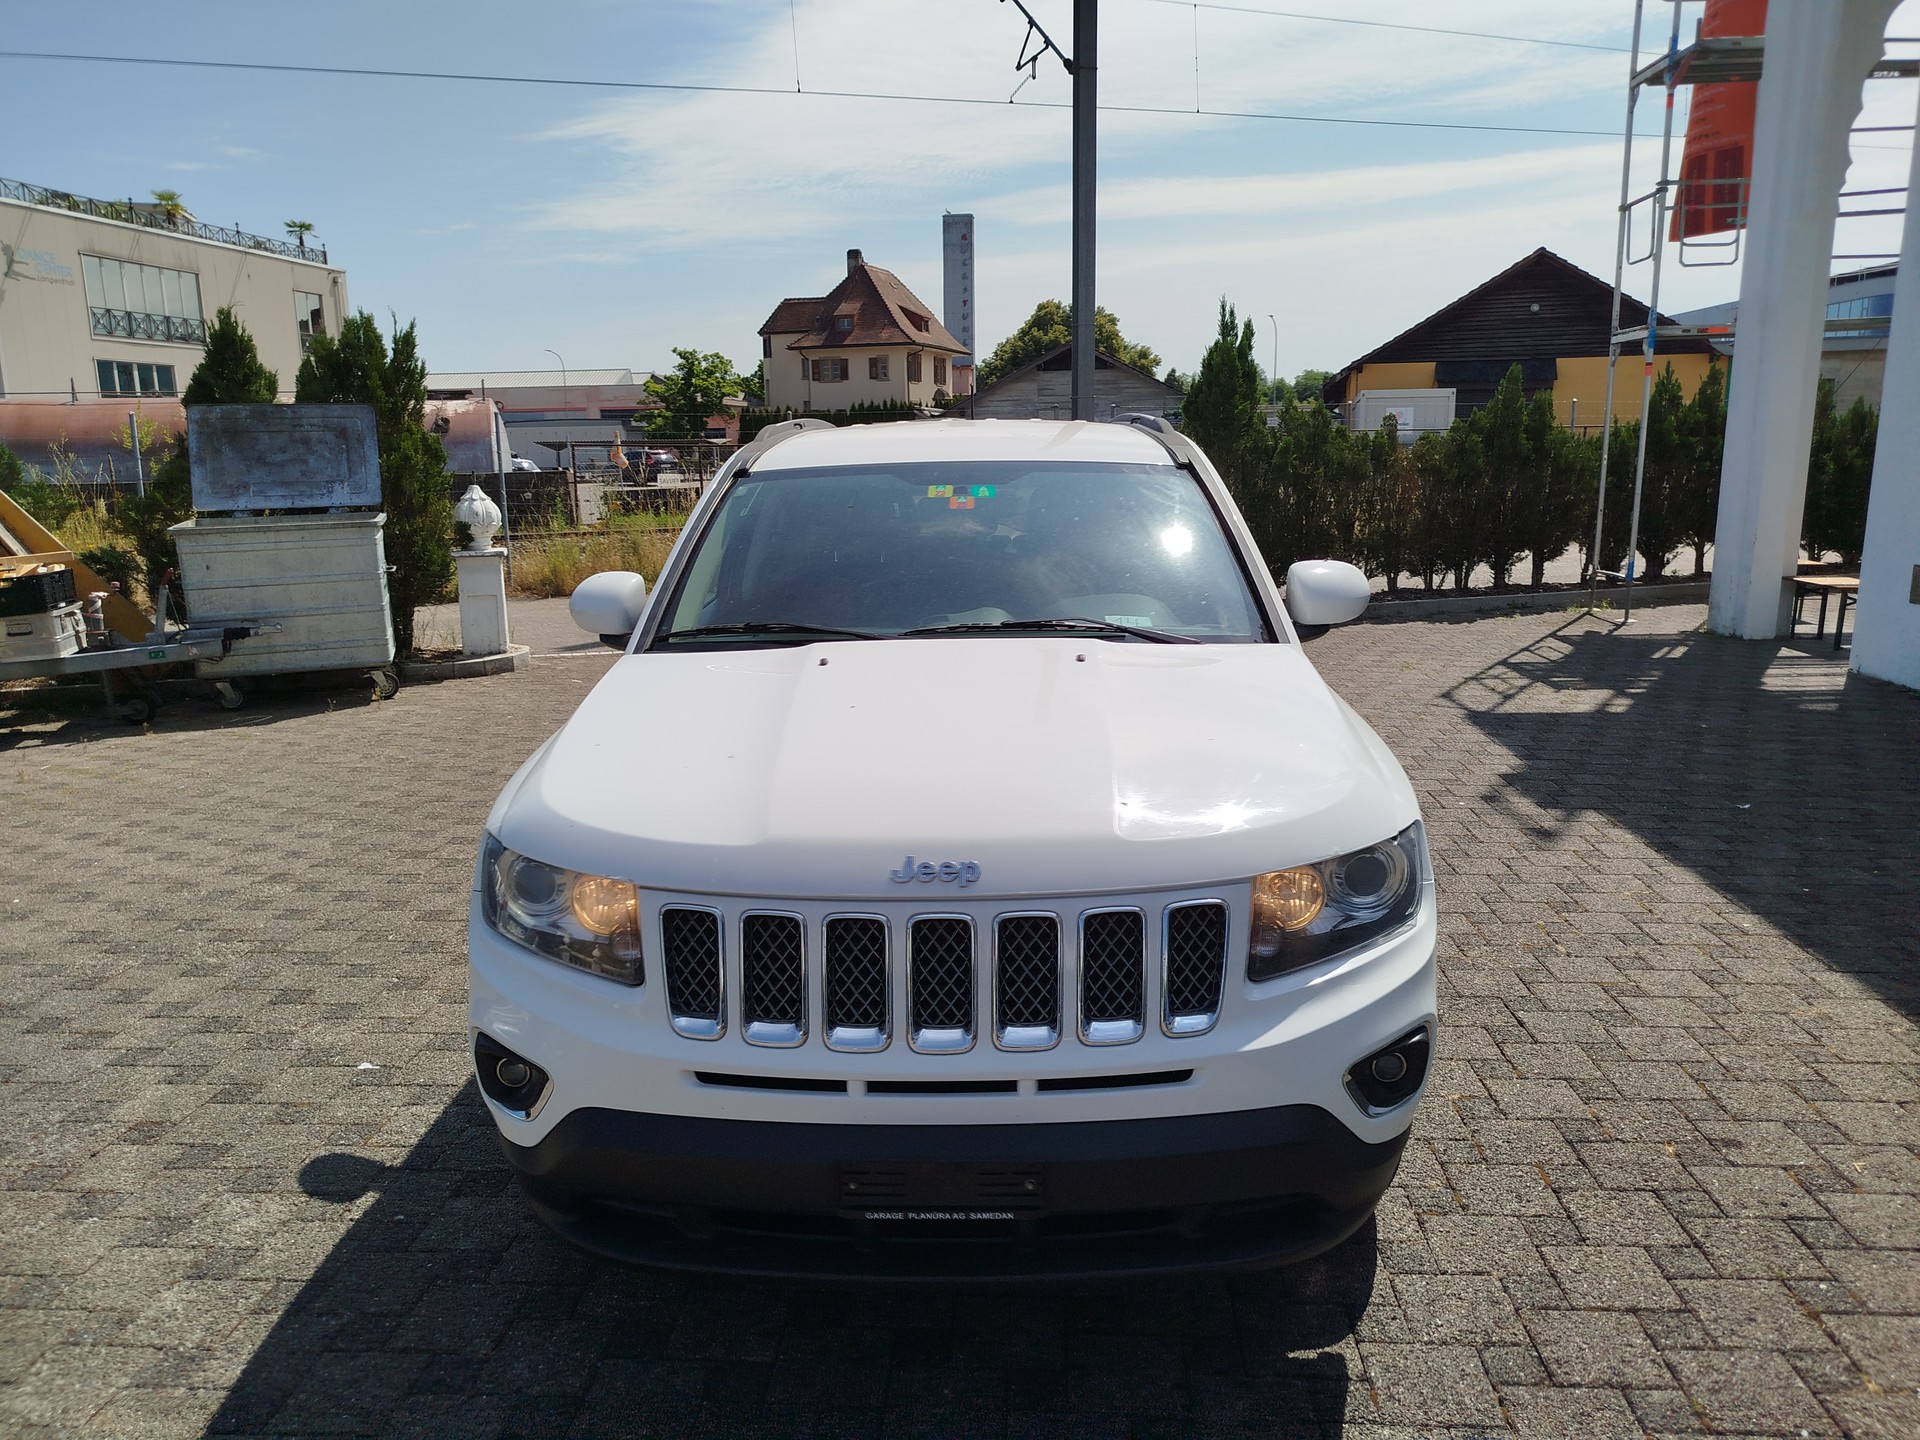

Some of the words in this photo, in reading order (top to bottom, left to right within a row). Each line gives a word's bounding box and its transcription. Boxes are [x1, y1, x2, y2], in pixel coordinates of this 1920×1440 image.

[17, 248, 56, 265] DANCE
[36, 264, 73, 277] CENTER
[888, 855, 982, 888] Jeep
[864, 1212, 905, 1220] GARAGE
[952, 1212, 966, 1220] AG
[969, 1212, 1015, 1220] SAMEDAN
